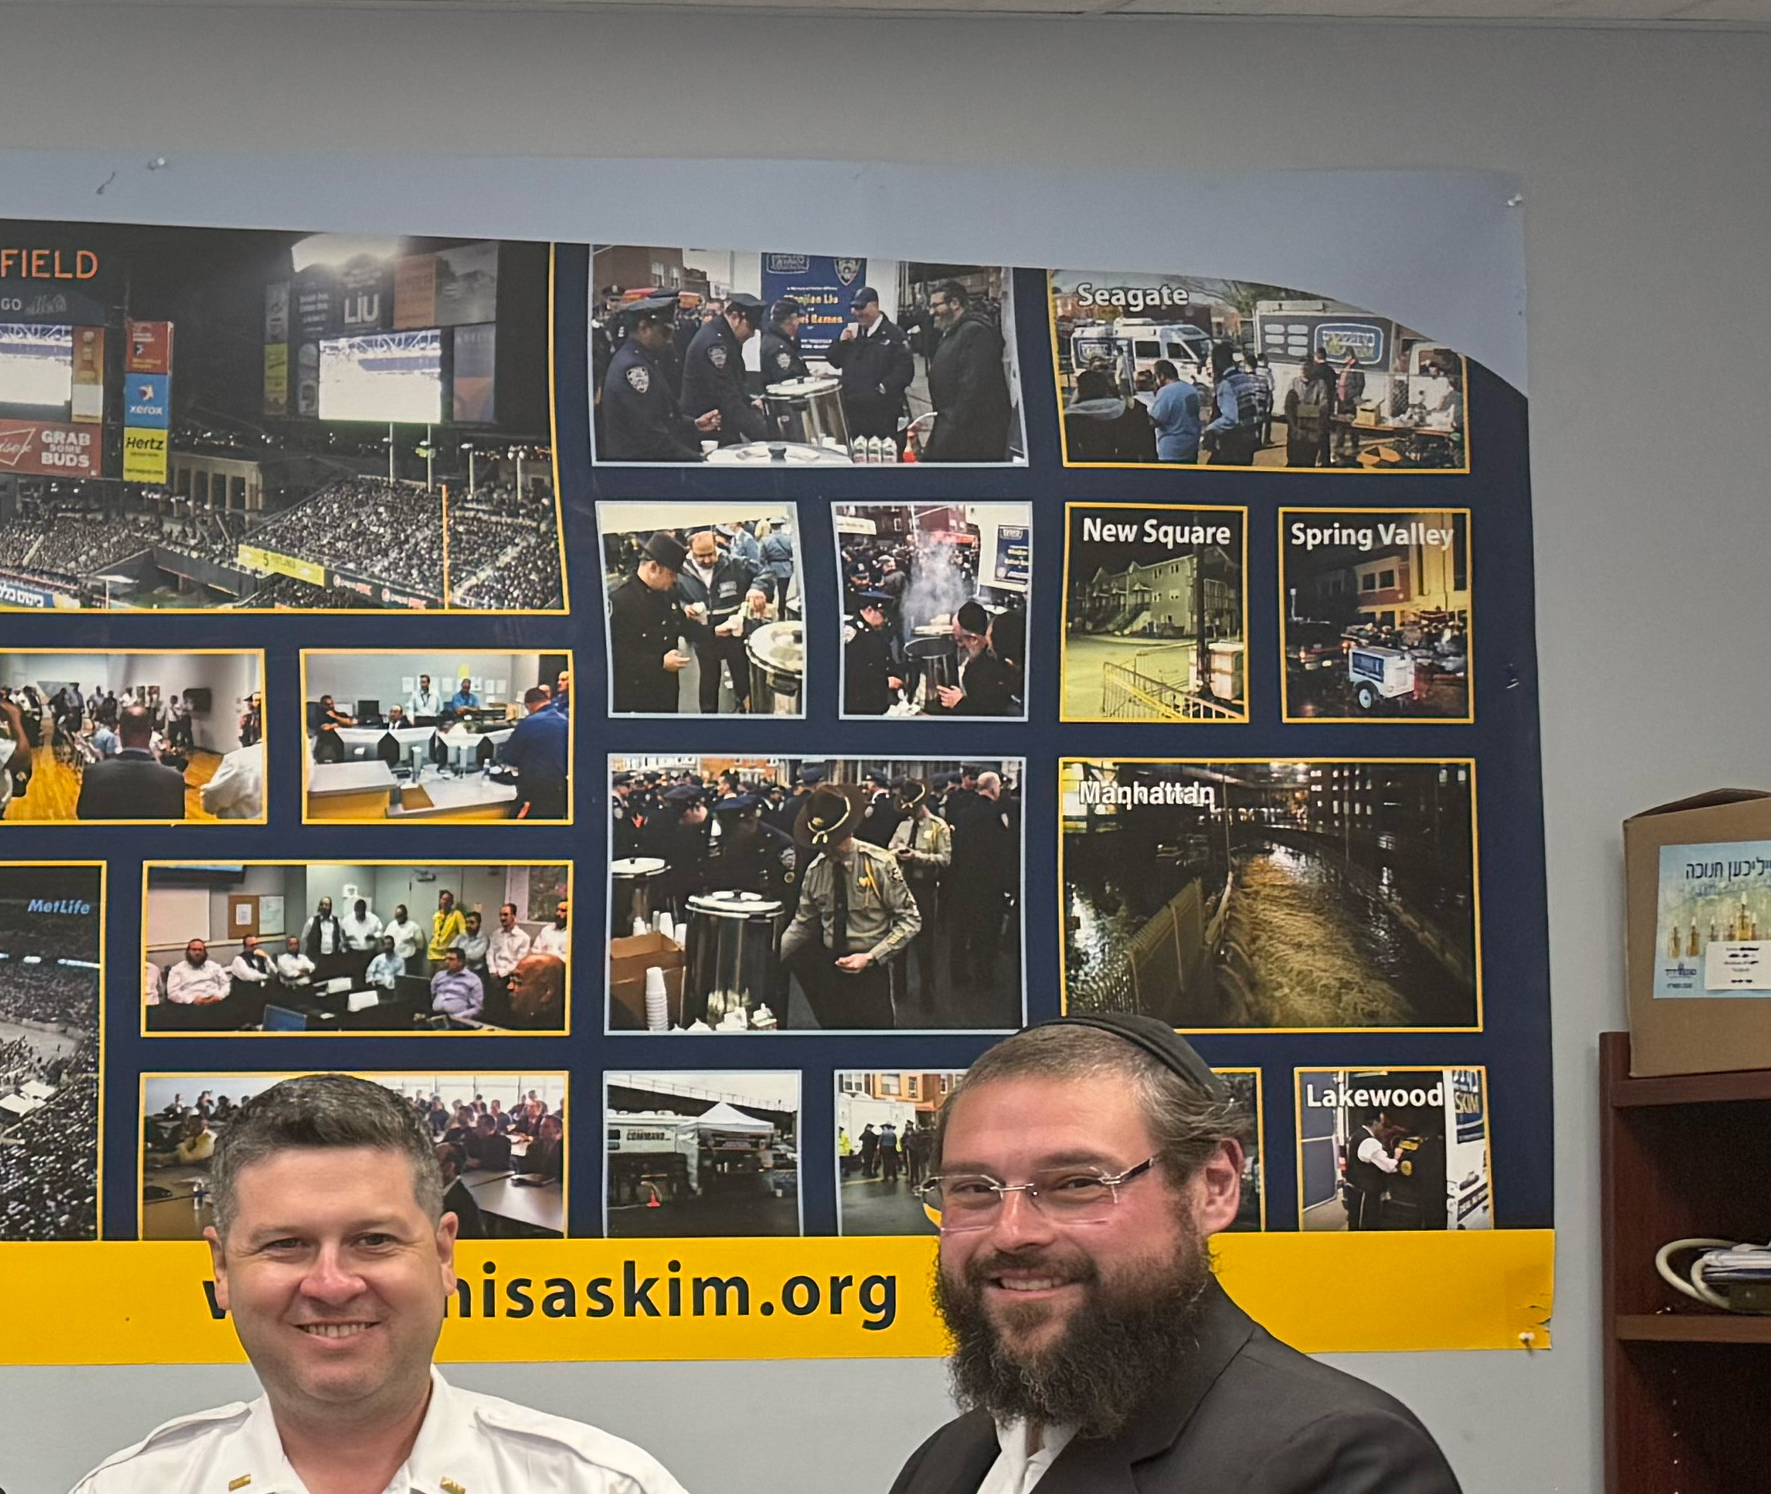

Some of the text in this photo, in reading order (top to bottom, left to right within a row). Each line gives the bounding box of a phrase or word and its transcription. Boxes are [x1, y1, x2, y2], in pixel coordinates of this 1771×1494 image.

[1, 250, 98, 279] FIELD
[1, 298, 22, 311] GO
[1077, 283, 1189, 312] Seagate
[130, 405, 163, 415] xerox
[41, 430, 90, 446] GRAB
[126, 437, 163, 450] Hertz
[41, 453, 90, 467] BUDS
[1083, 518, 1231, 550] New Square
[1291, 523, 1454, 551] Spring Valley
[1080, 781, 1215, 804] Manhattan
[27, 899, 91, 914] MetLife
[1307, 1082, 1444, 1107] Lakewood
